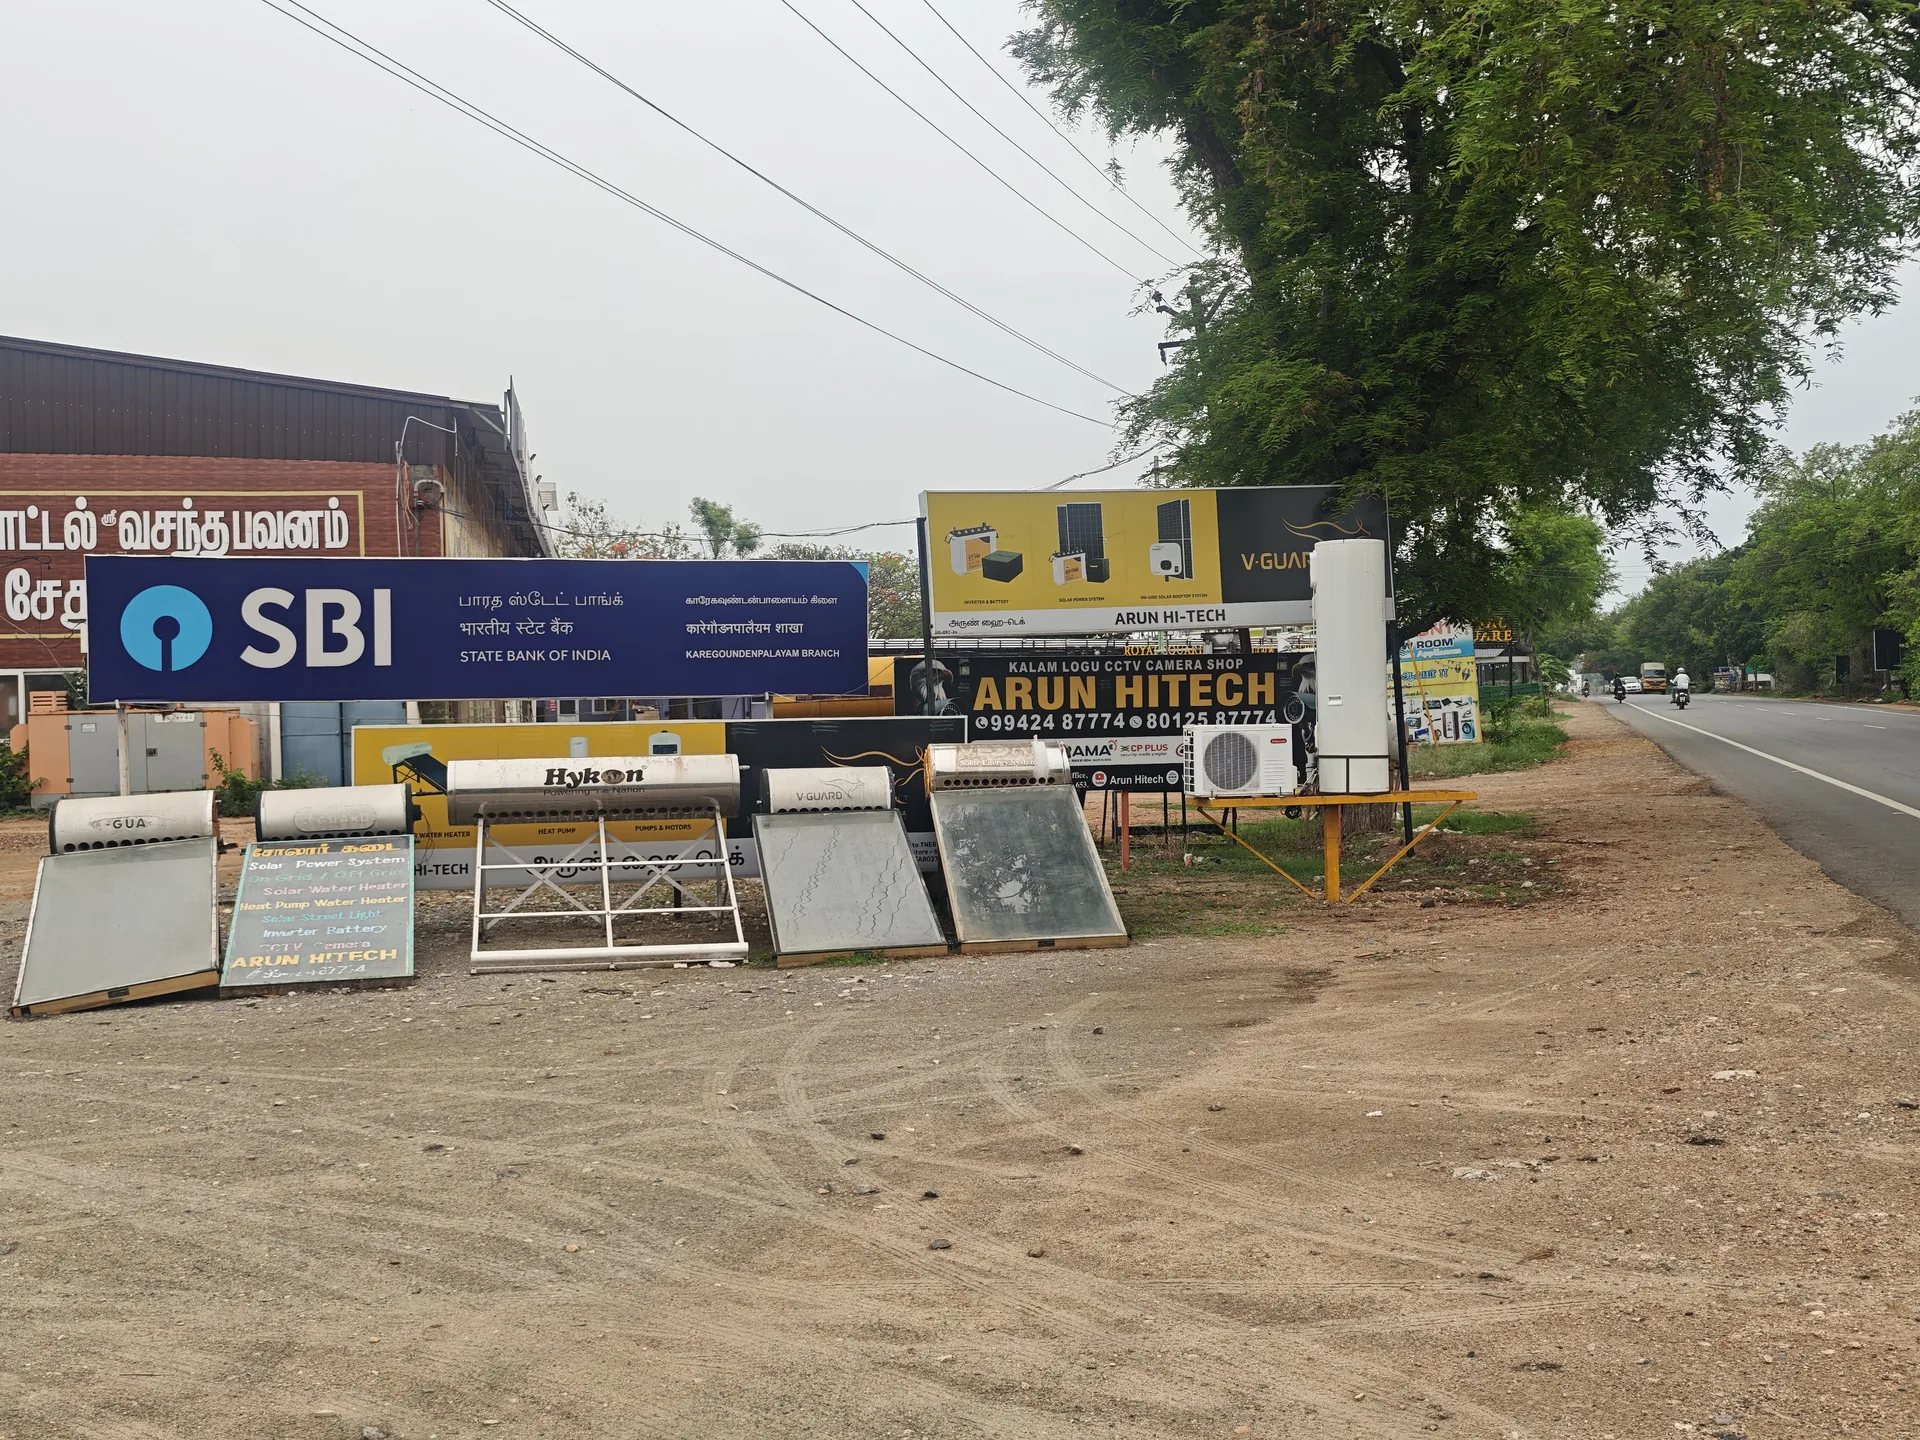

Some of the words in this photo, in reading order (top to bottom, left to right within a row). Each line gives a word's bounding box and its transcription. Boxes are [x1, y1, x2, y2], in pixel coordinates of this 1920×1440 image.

[1241, 552, 1313, 570] V-GUAR
[459, 595, 503, 611] பாரத
[508, 591, 570, 606] ஸ்டேட்
[575, 591, 624, 606] பாங்க்
[810, 595, 838, 604] கிளை
[949, 618, 979, 628] அருண்
[1115, 611, 1159, 625] ARUN
[1164, 609, 1226, 624] HI-TECH
[240, 587, 392, 669] SBI
[459, 618, 511, 635] भारतीय
[515, 617, 545, 634] स्टेट
[550, 617, 574, 634] बैंक
[775, 622, 804, 634] शाखा
[1124, 645, 1158, 655] ROYA
[1416, 638, 1453, 648] ROOM
[460, 651, 503, 662] STATE
[507, 650, 545, 661] BANK
[549, 650, 568, 661] OF
[572, 650, 611, 661] INDIA
[686, 650, 800, 658] KAREGOUNDENPALAYAM
[801, 649, 840, 657] BRANCH
[1009, 661, 1057, 673] KALAM
[1062, 661, 1100, 672] LOGU
[1104, 660, 1141, 672] CCTV
[1145, 659, 1202, 671] CAMERA
[1207, 658, 1243, 670] SHOP
[973, 676, 1096, 711] ARUN
[1115, 672, 1275, 708] HITECH
[991, 714, 1054, 731] 99424
[1062, 712, 1125, 730] 87774
[1146, 711, 1207, 729] 80125
[1131, 744, 1143, 752] CP
[544, 768, 644, 789] Hykon
[1110, 776, 1132, 785] Arun
[1135, 774, 1164, 784] Hitech
[252, 843, 330, 858] சோலார்
[341, 843, 401, 853] கடை
[348, 856, 405, 867] System
[276, 872, 312, 881] Grid
[370, 868, 404, 877] Grid
[414, 863, 469, 876] HI-TECH
[264, 886, 303, 896] Solar
[309, 884, 357, 894] Water
[359, 881, 409, 892] Heater
[240, 902, 272, 911] Heat
[275, 901, 310, 910] Pump
[314, 899, 358, 908] Water
[361, 895, 408, 905] Heater
[262, 914, 301, 923] Solar
[301, 911, 344, 922] Street
[350, 909, 384, 921] Light
[263, 928, 319, 938] Inverter
[230, 954, 299, 968] ARUN
[310, 949, 398, 964] HITECH
